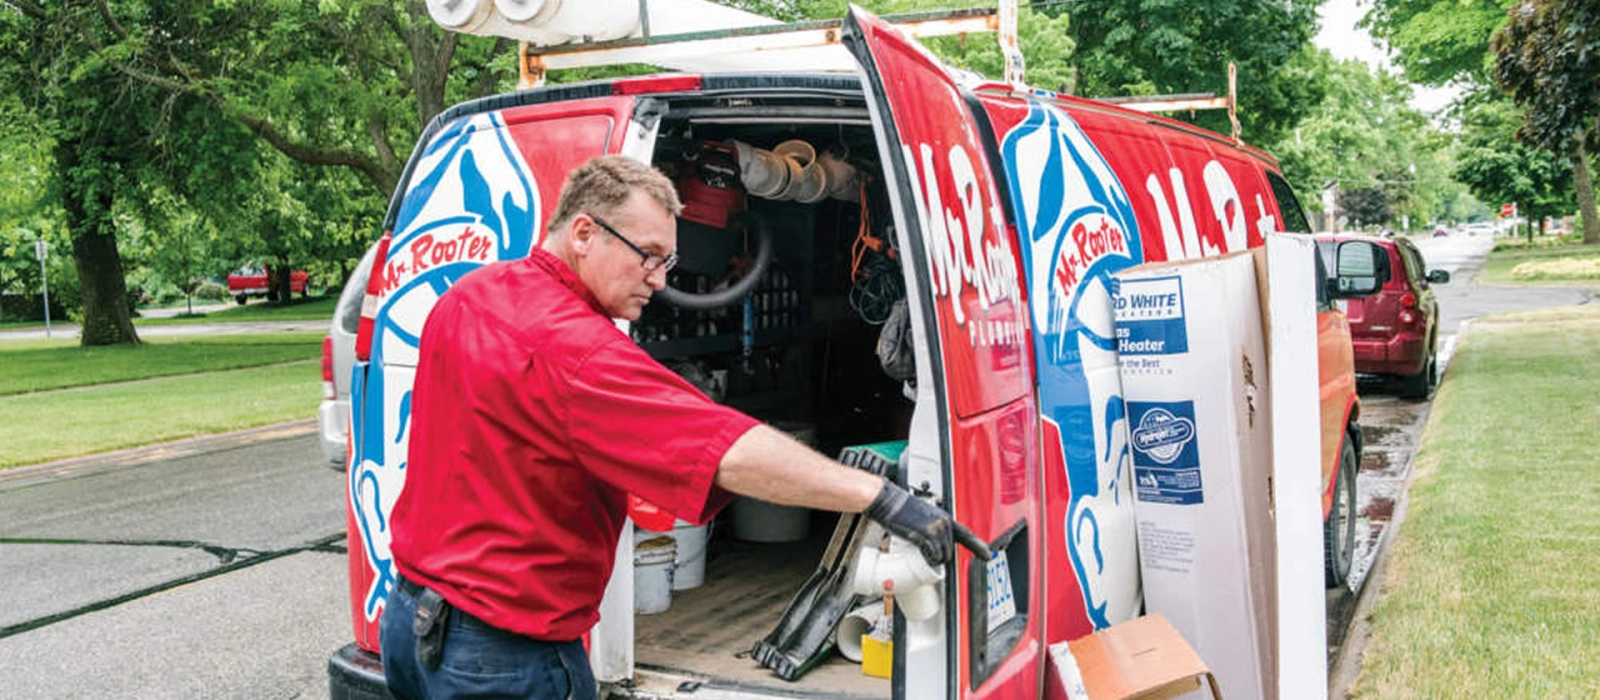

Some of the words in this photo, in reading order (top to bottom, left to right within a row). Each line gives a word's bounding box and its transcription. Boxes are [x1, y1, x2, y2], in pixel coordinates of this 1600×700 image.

[411, 226, 491, 275] Rooter
[1072, 217, 1123, 268] Rooter
[1131, 293, 1177, 309] WHITE
[1118, 338, 1165, 352] Heater
[1142, 358, 1160, 369] Best
